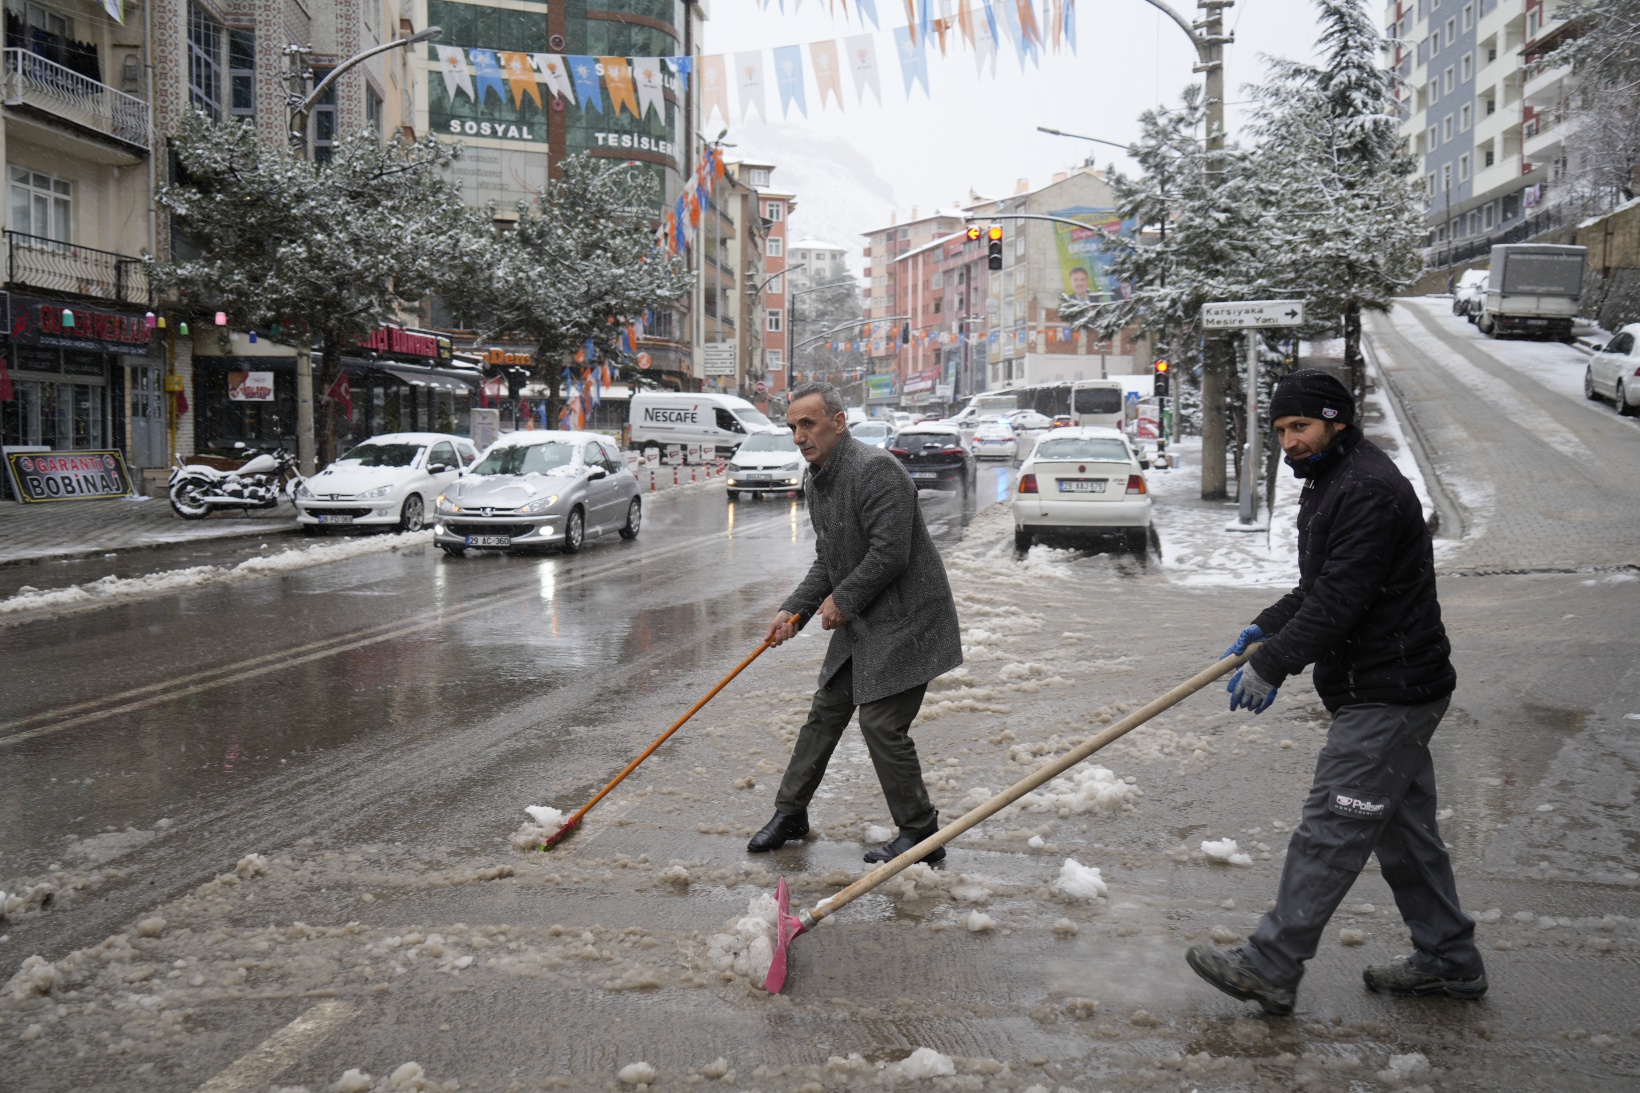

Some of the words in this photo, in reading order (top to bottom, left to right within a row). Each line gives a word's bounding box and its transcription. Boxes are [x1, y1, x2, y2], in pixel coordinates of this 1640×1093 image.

[450, 119, 533, 139] SOSYAL
[1206, 318, 1244, 326] Mesire
[644, 404, 698, 424] NESCAFÉ
[36, 457, 104, 473] GARANTİ
[27, 471, 122, 498] BOBİNAJ
[1064, 482, 1072, 490] 29
[470, 537, 479, 545] 29
[482, 537, 491, 545] AC
[495, 537, 509, 545] 360
[1352, 799, 1384, 812] Polisan
